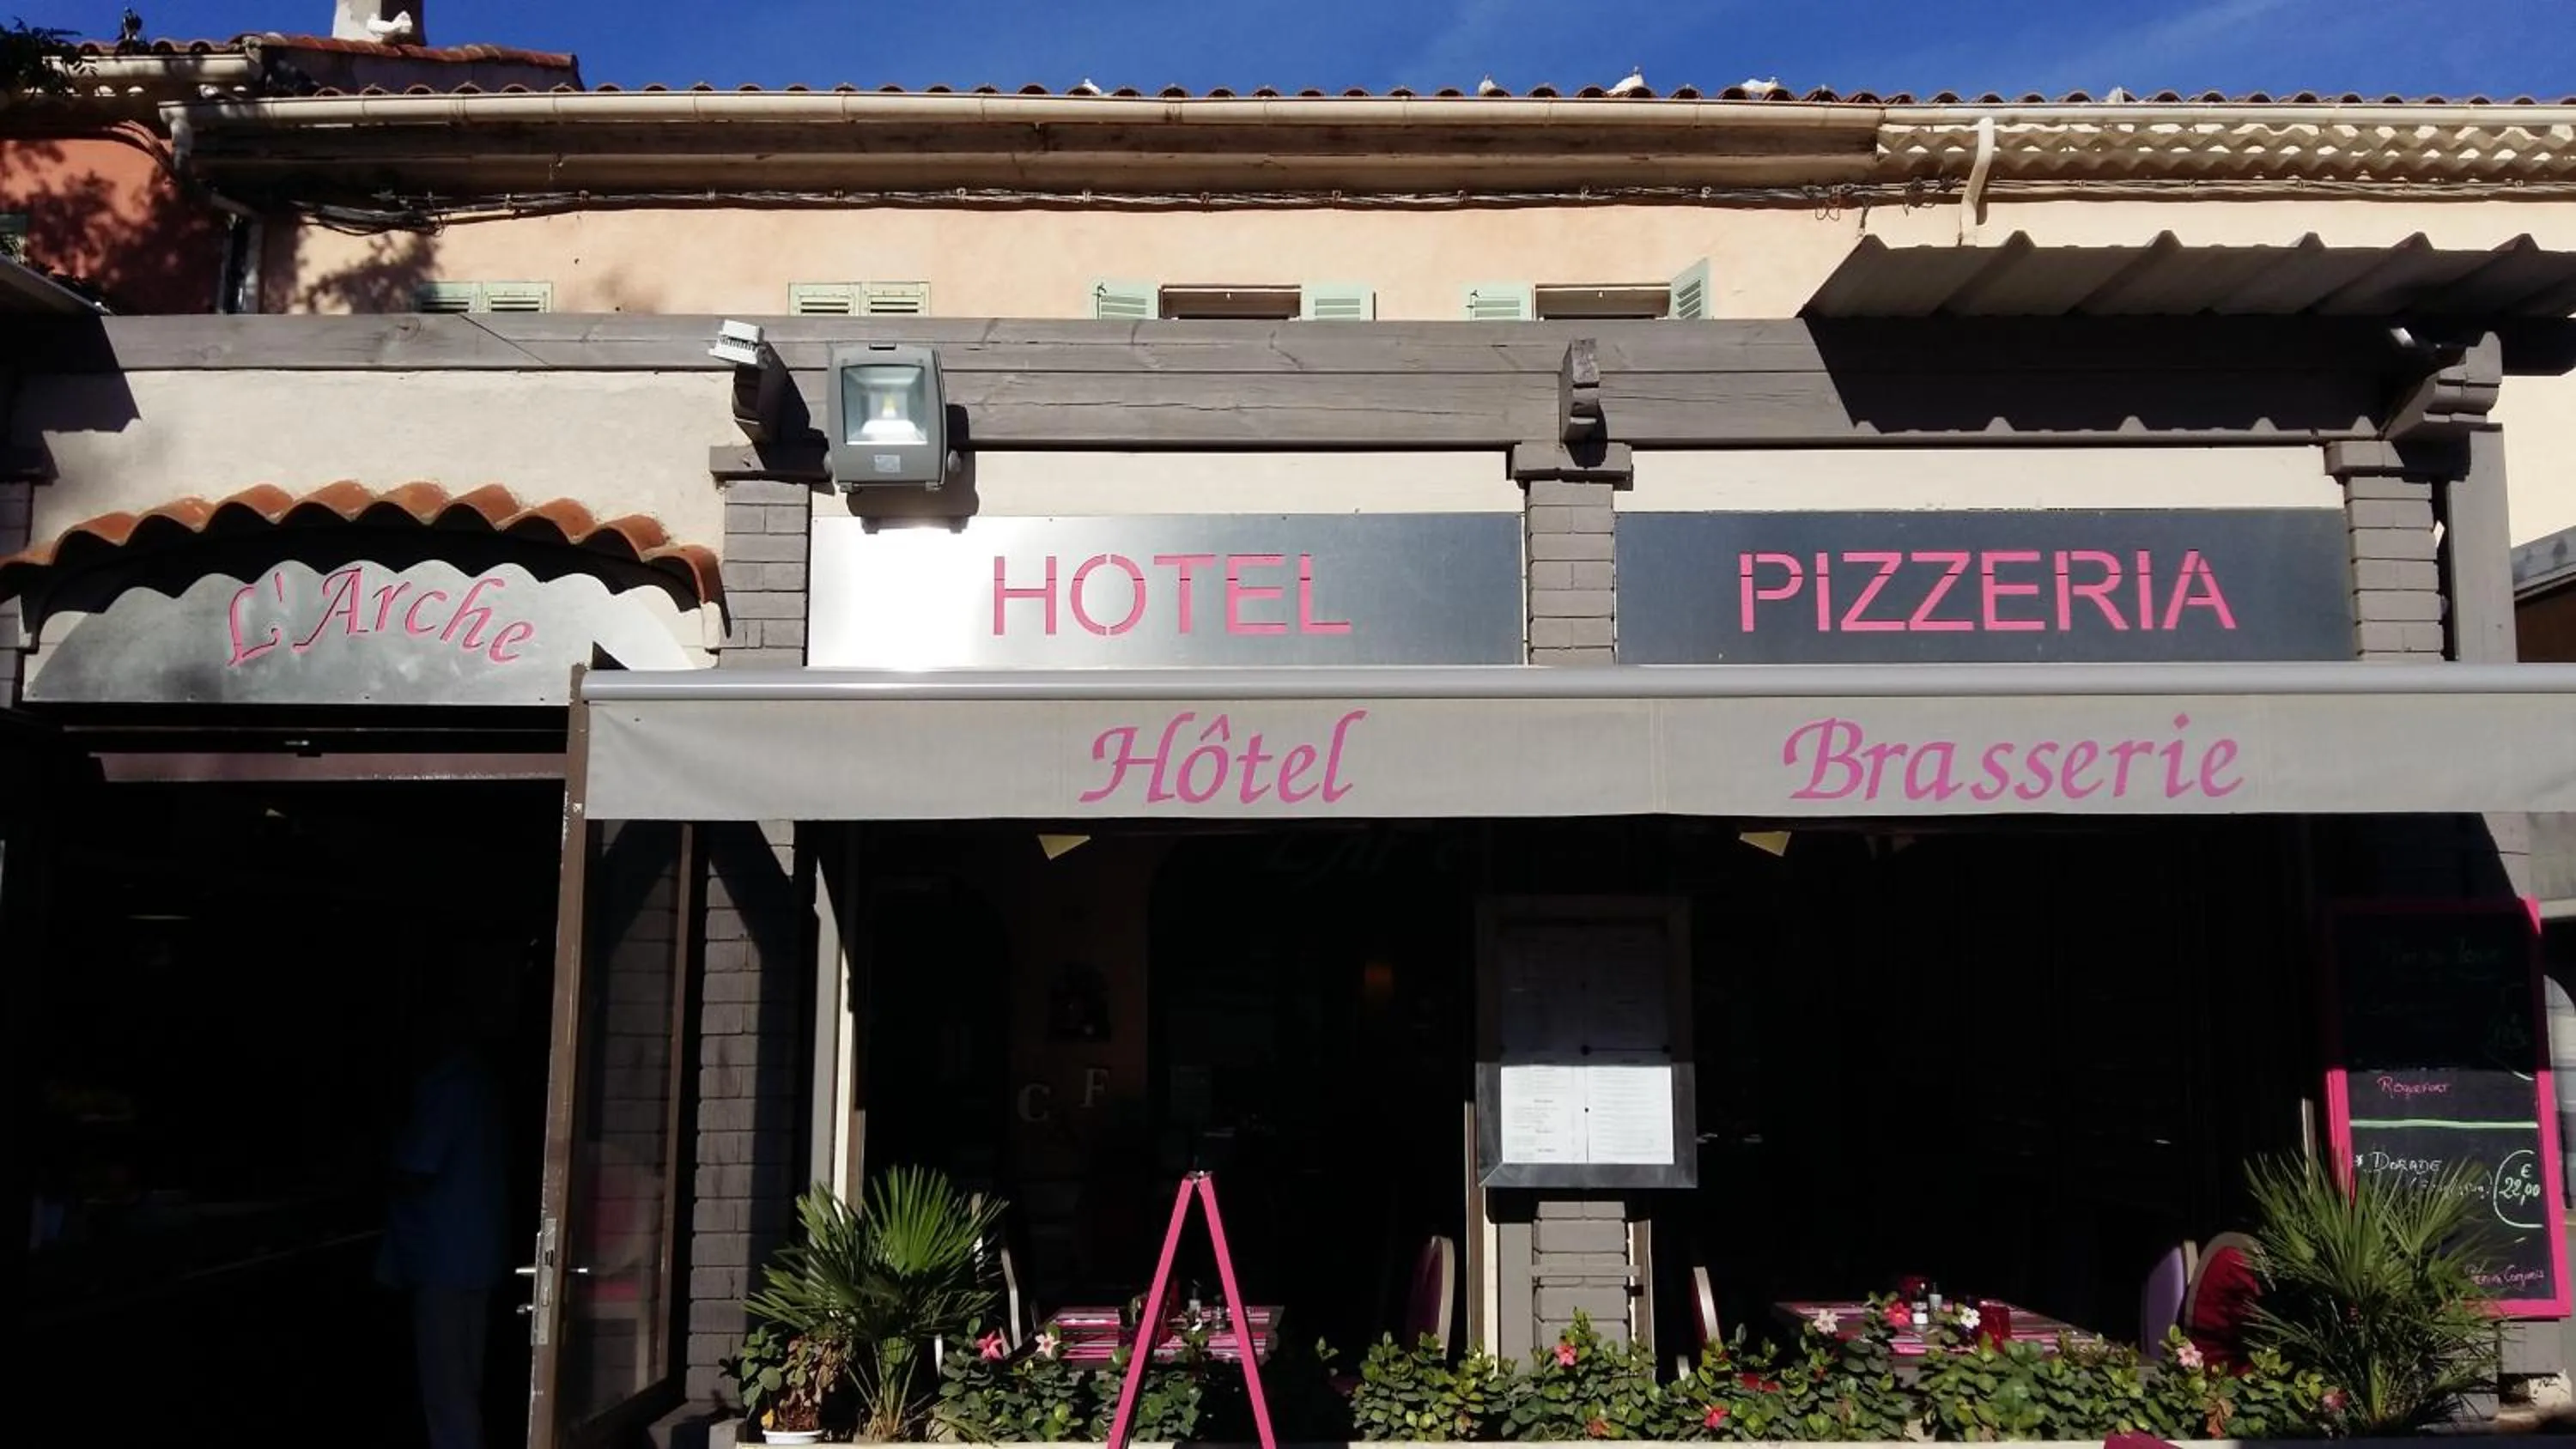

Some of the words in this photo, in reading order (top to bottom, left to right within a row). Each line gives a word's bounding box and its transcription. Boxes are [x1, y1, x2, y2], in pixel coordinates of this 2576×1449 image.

[228, 566, 535, 667] L'Arche
[993, 554, 1352, 636] HOTEL
[1738, 549, 2237, 634] PIZZERIA
[1079, 710, 1367, 805] Hôtel
[1781, 712, 2245, 803] Brasserie
